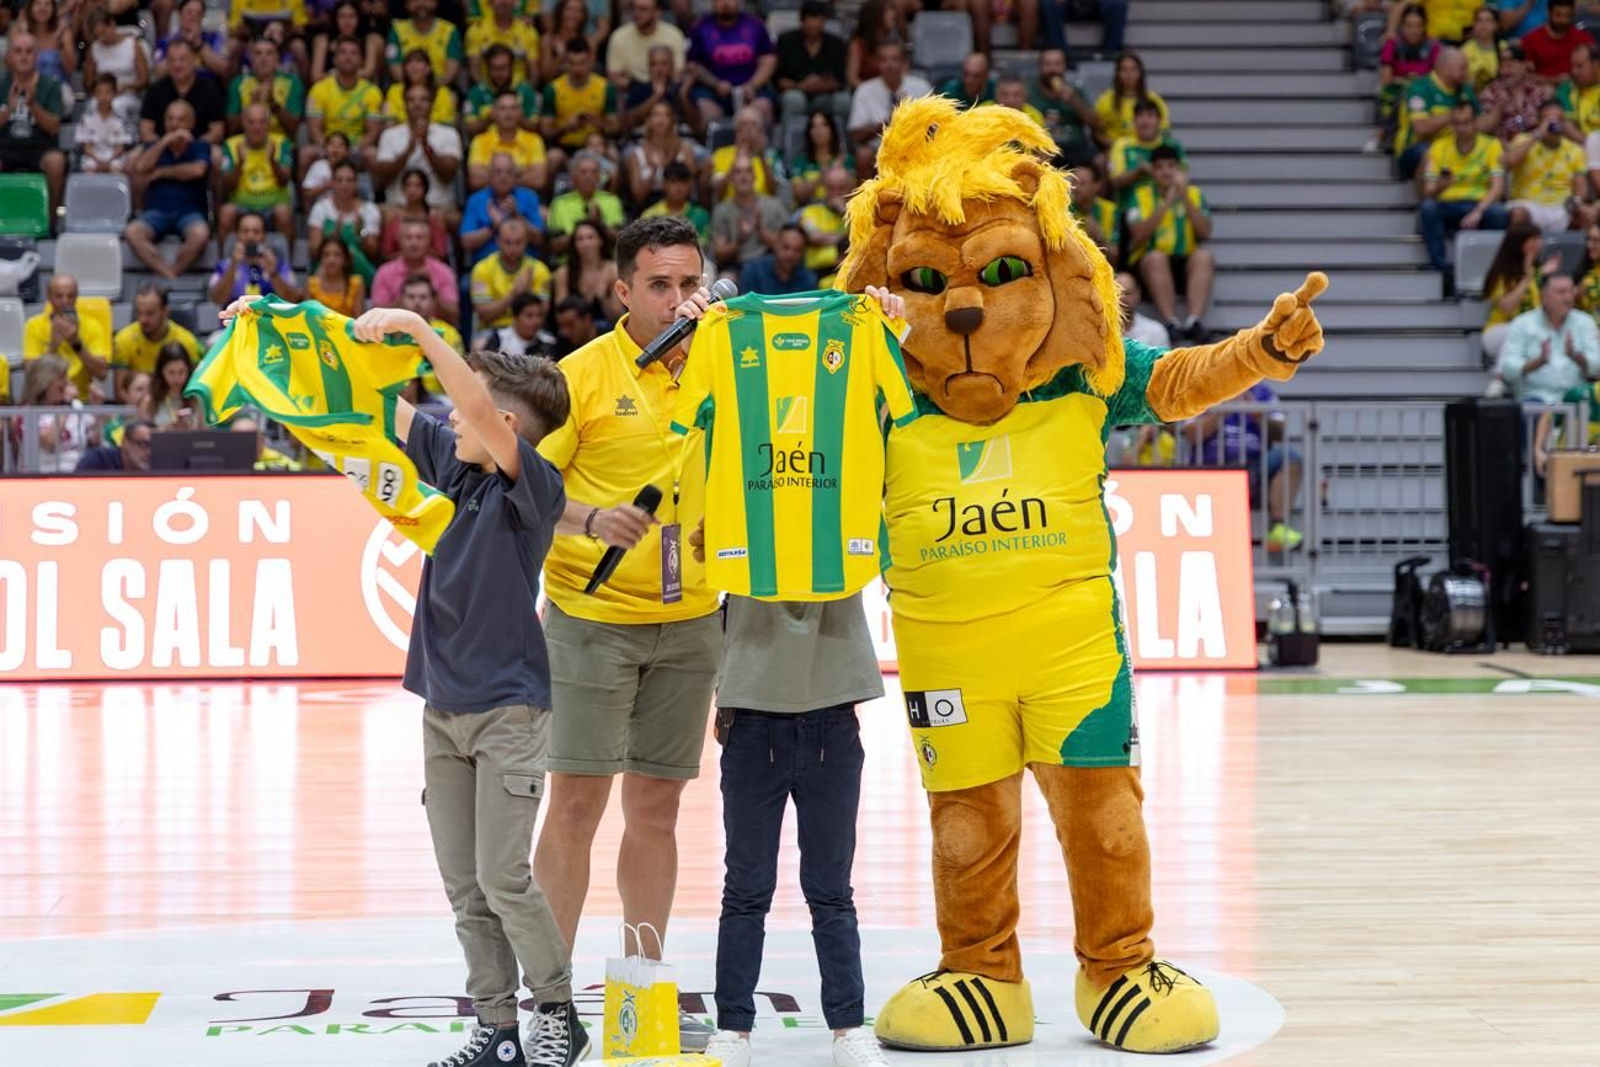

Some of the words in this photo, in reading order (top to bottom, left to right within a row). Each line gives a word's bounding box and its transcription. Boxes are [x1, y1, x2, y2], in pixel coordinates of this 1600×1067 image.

[758, 441, 825, 477] Jaén
[787, 477, 838, 489] INTERIOR
[30, 486, 291, 546] SIÓN
[932, 488, 1047, 542] Jaén
[920, 539, 988, 562] PARAÍSO
[992, 532, 1067, 552] INTERIOR
[100, 558, 299, 670] SALA
